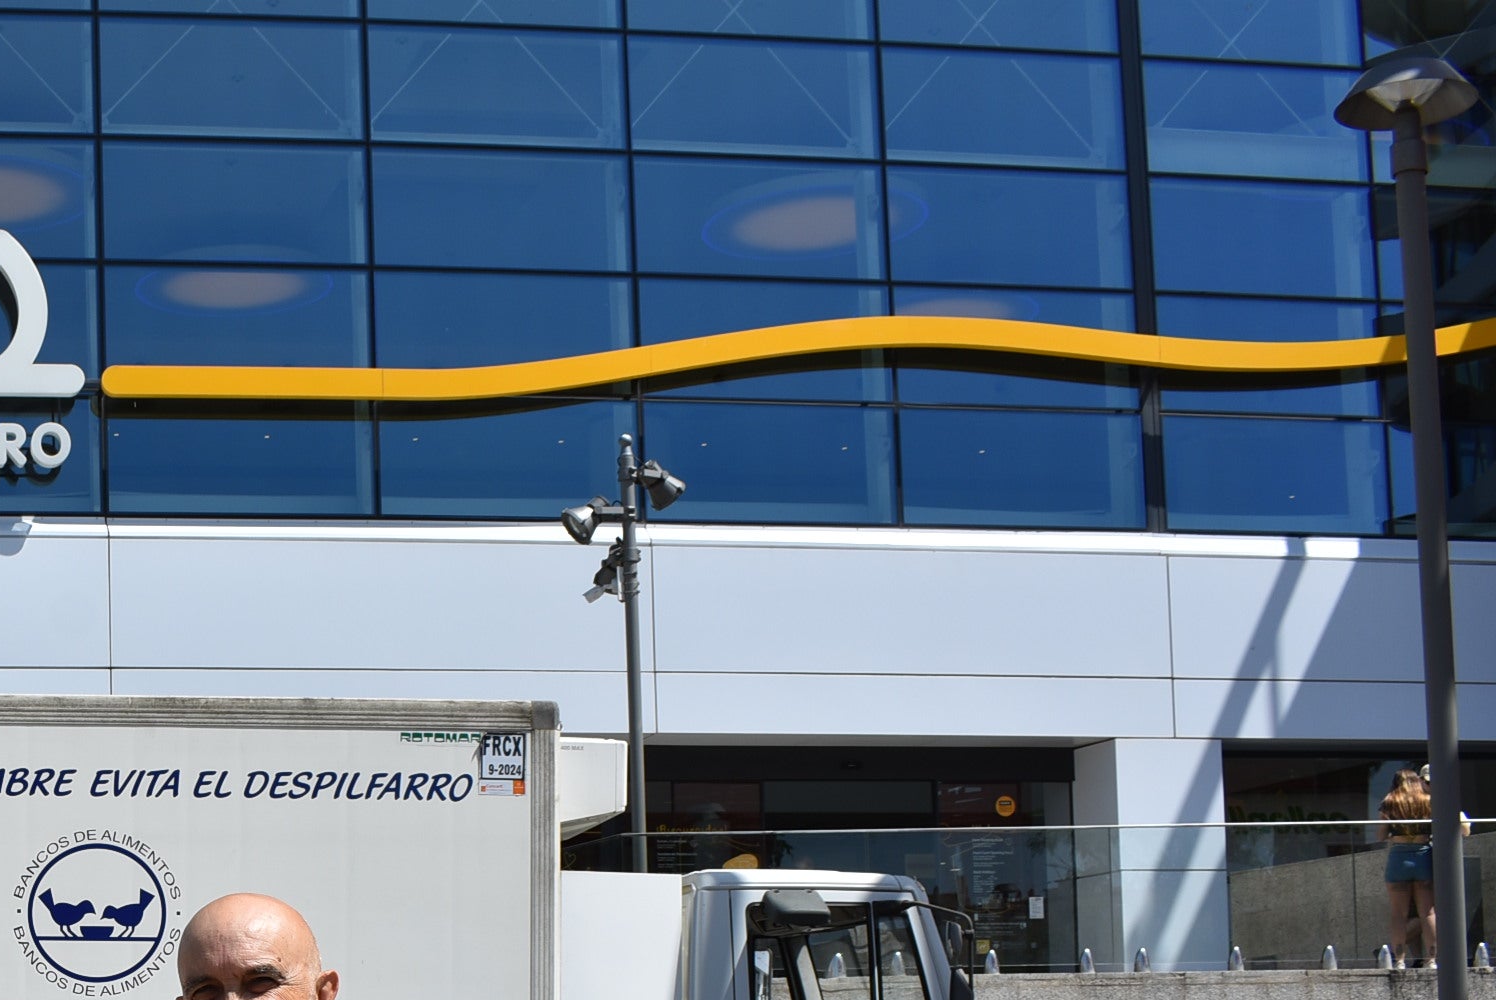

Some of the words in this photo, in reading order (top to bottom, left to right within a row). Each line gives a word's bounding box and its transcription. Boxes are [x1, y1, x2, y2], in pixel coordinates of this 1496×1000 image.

[482, 735, 522, 757] FRCX
[90, 769, 180, 798] EVITA
[193, 770, 232, 799] EL
[243, 770, 474, 802] DESPILFARRO
[488, 764, 522, 776] 9-2024
[13, 836, 70, 899] BANCOS
[73, 829, 97, 843] DE
[100, 829, 181, 900] ALIMENTOS
[13, 925, 69, 990] BANCOS
[72, 983, 96, 997] DE
[100, 928, 182, 997] ALIMENTOS
